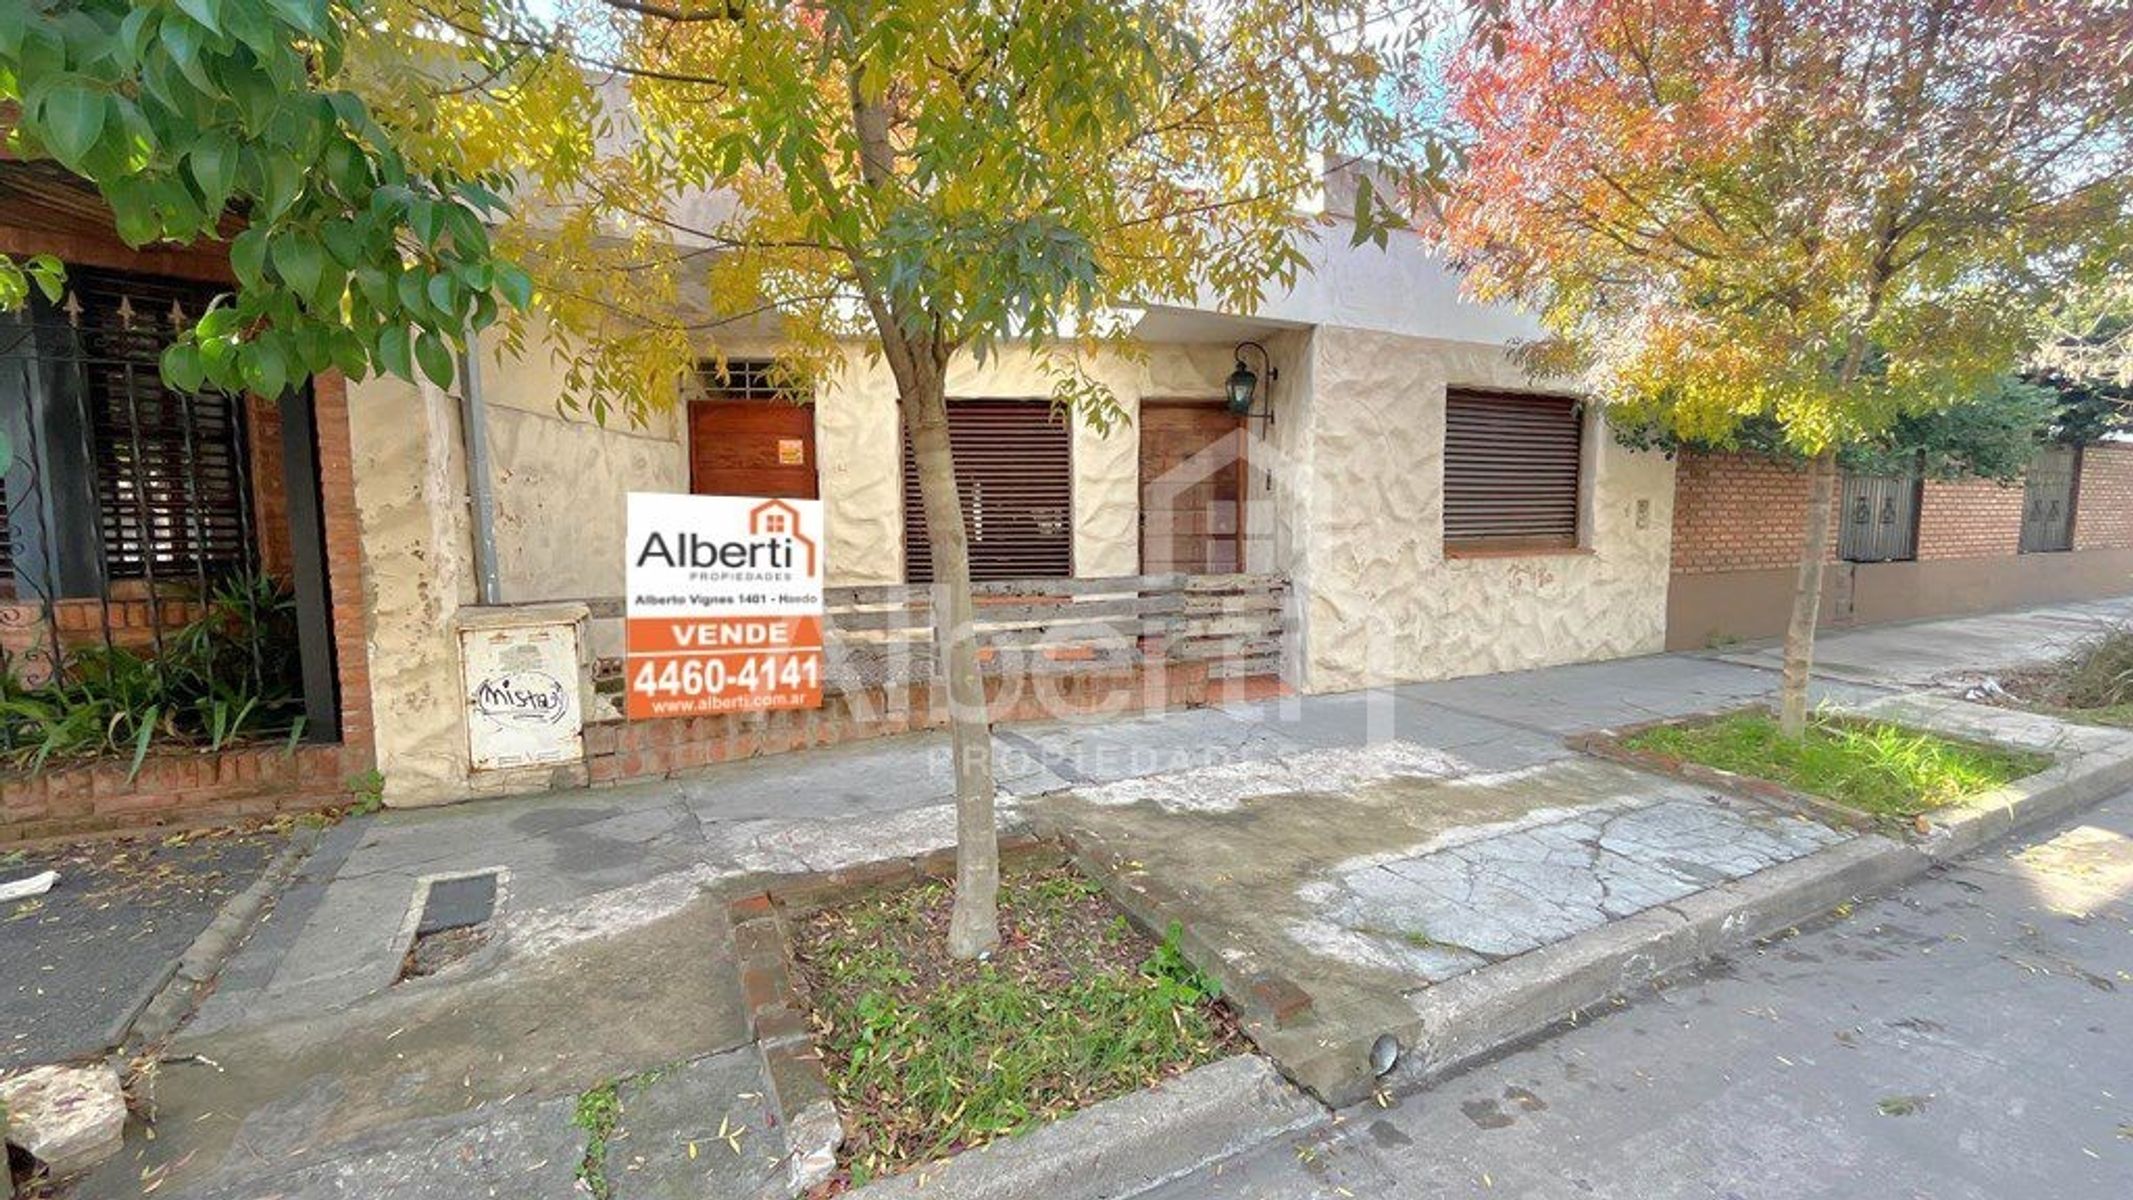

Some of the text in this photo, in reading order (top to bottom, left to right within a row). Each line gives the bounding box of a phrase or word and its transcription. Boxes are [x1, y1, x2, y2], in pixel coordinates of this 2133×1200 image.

[636, 531, 792, 568] Alberti
[689, 571, 792, 582] PROPIEDADES
[635, 594, 686, 605] Alberto
[689, 594, 734, 607] Vignes
[672, 622, 788, 646] VENDE
[633, 654, 819, 697] 4460-4141
[651, 693, 807, 713] www.alberti.com.ar
